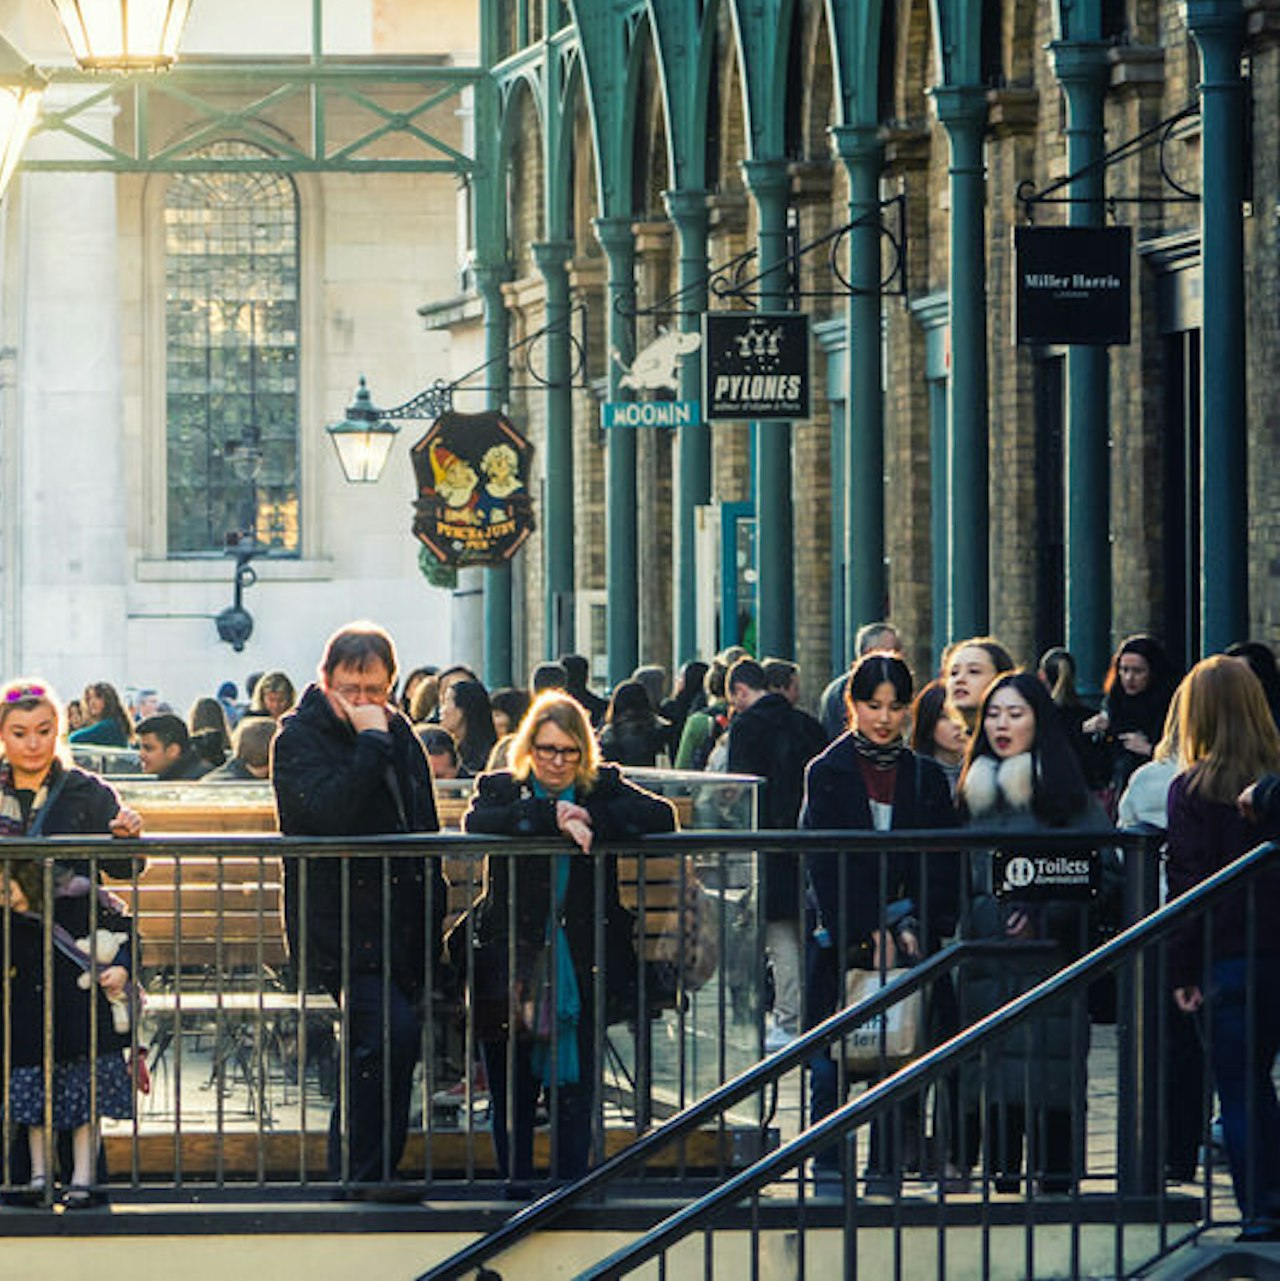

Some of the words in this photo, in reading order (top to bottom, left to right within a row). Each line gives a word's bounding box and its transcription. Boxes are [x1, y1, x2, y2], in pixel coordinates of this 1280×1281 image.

[1024, 274, 1070, 289] Miller
[1072, 274, 1120, 289] Harris
[714, 375, 802, 401] PYLONES
[614, 403, 690, 427] MOOMIN
[1034, 857, 1090, 875] Toilets
